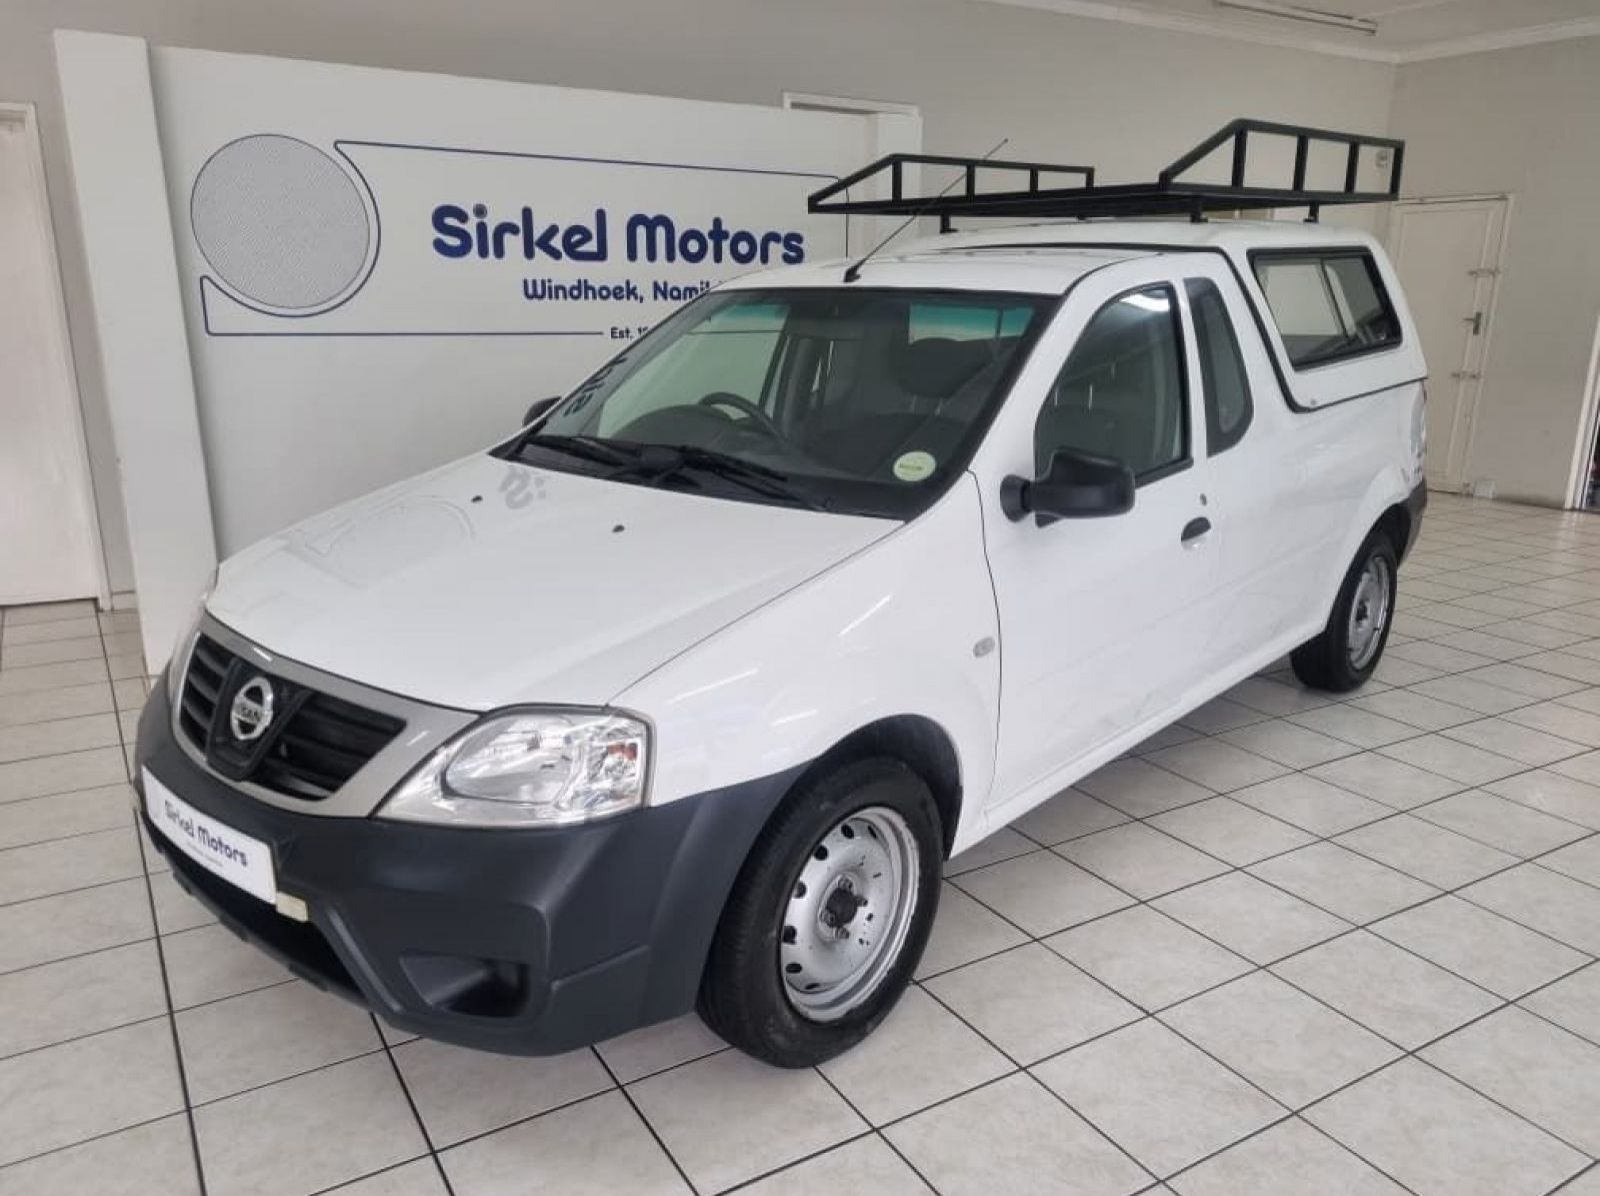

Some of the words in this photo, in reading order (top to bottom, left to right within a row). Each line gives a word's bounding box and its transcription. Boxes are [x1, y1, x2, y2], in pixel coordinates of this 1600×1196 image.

[431, 203, 608, 262] Sirkel
[626, 213, 805, 264] Motors
[523, 279, 644, 303] Windhoek,
[610, 326, 634, 340] Est.
[198, 825, 248, 867] Motors
